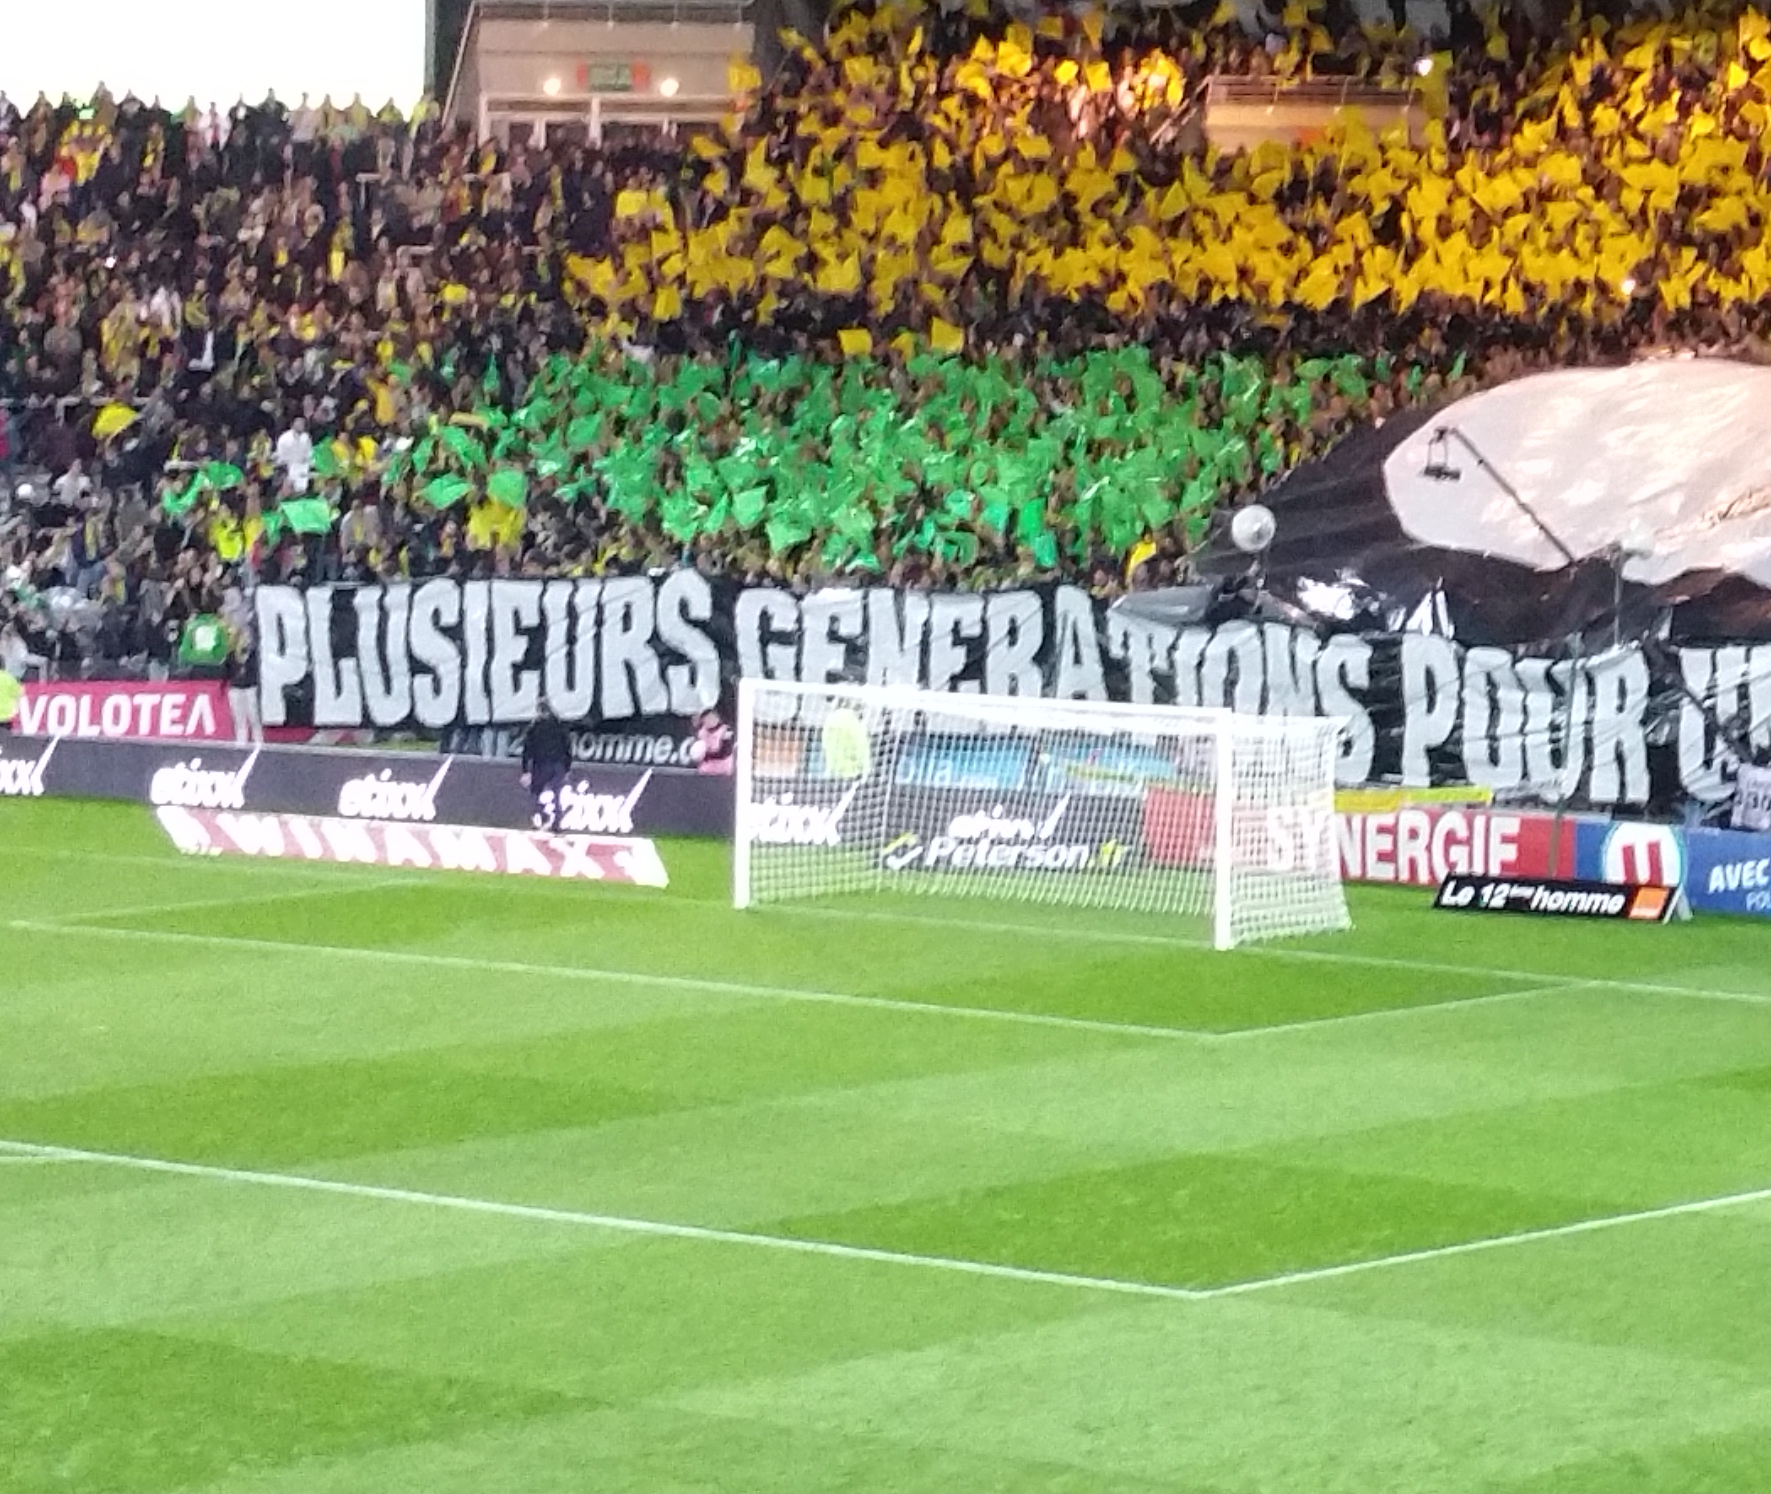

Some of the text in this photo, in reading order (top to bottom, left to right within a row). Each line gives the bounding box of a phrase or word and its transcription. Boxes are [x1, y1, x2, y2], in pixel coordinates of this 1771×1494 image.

[255, 568, 723, 726] PLUSIEURS
[735, 585, 1375, 785] GENERATIONS
[1400, 632, 1650, 805] POUR
[1708, 857, 1771, 894] AVEC
[1441, 880, 1475, 907] Le
[1531, 885, 1626, 915] homme
